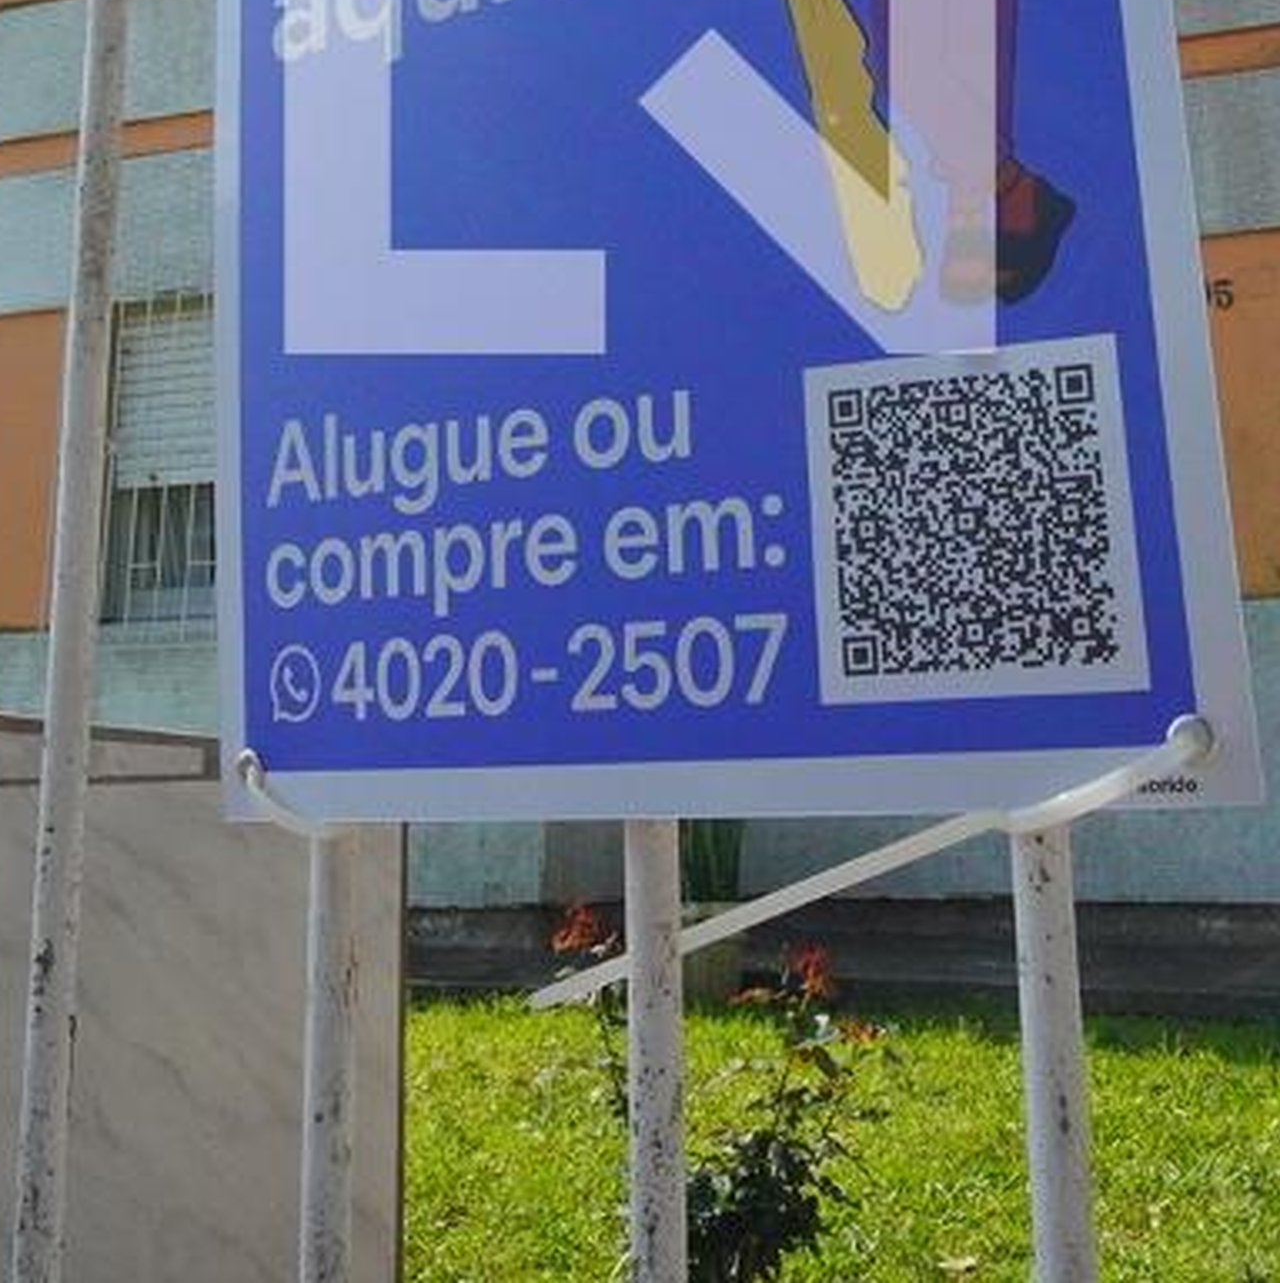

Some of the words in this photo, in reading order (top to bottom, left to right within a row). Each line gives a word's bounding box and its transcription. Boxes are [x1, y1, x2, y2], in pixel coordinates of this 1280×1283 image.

[266, 408, 549, 514] Alugue
[572, 389, 691, 469] ou
[266, 513, 578, 617] compre
[604, 494, 786, 580] em:
